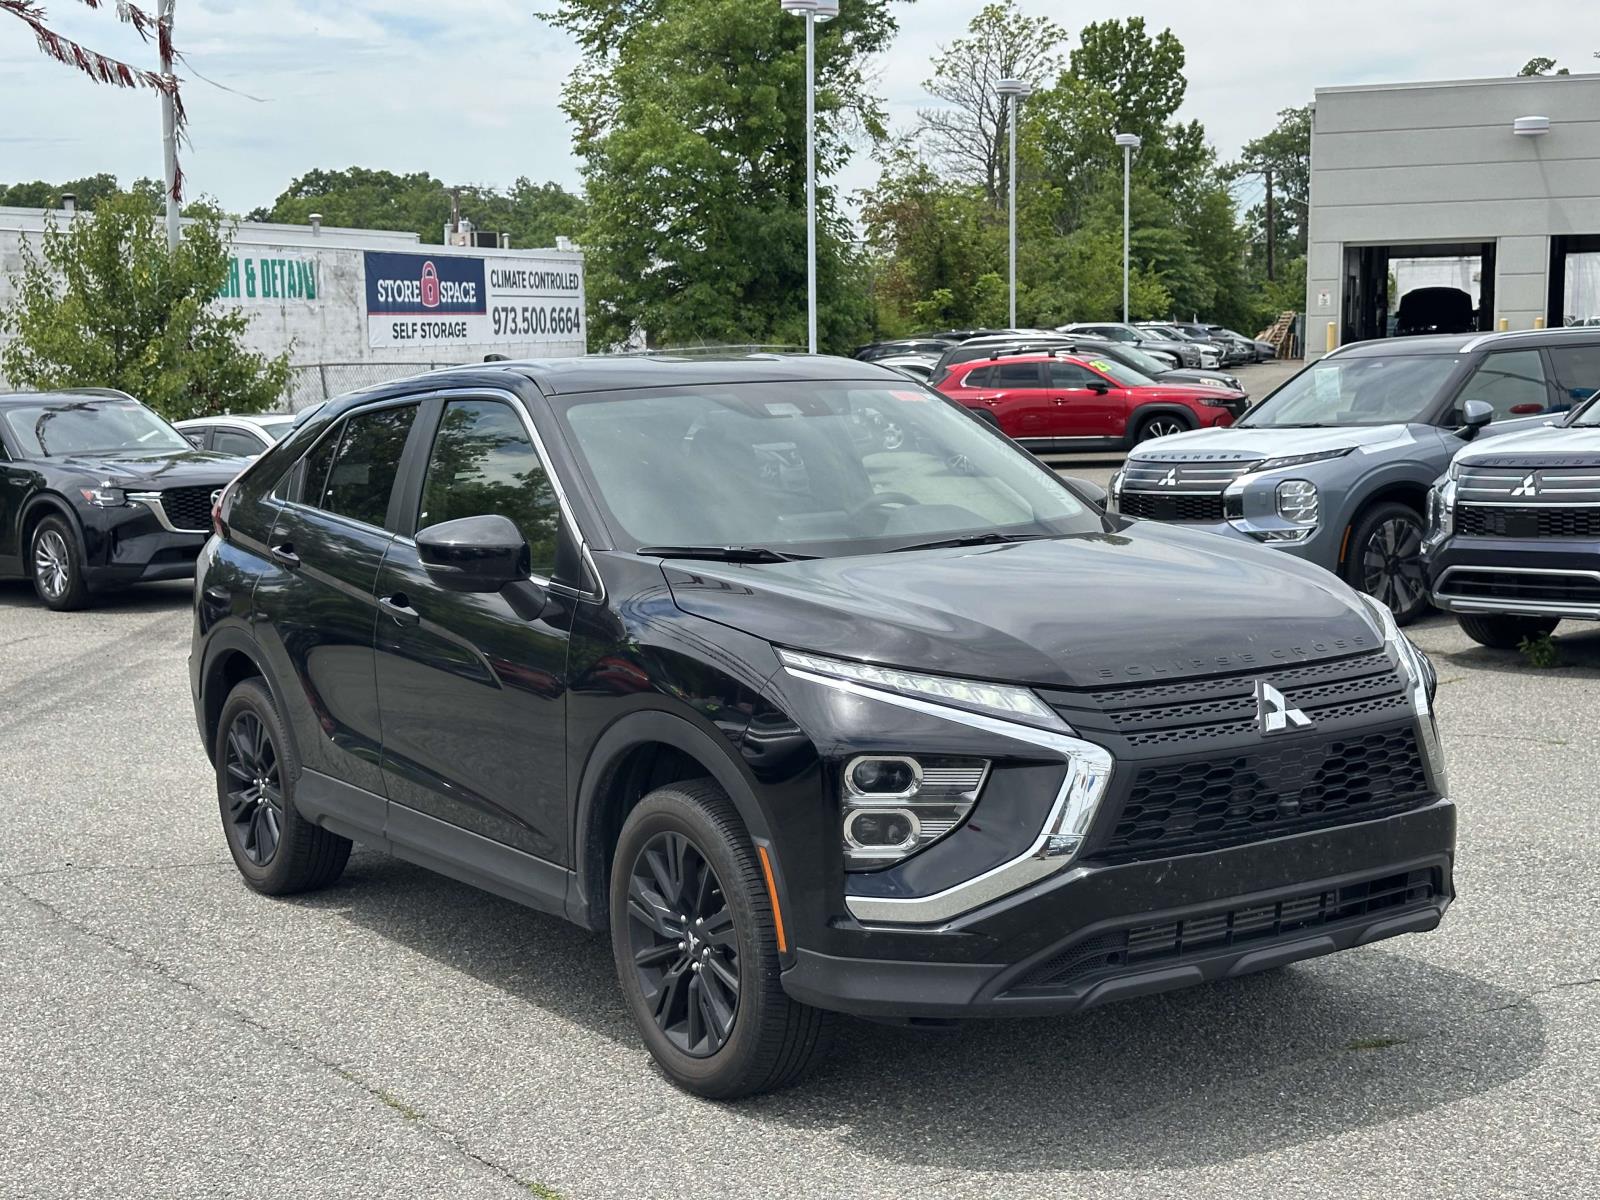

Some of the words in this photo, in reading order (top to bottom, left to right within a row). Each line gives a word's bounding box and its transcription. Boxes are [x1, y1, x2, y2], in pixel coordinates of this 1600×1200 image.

[244, 258, 256, 298] &
[377, 279, 421, 302] STORE
[440, 281, 476, 303] SPACE
[490, 269, 527, 289] CLIMATE
[528, 271, 579, 290] CONTROLLED
[392, 322, 417, 339] SELF
[420, 322, 467, 339] STORAGE
[492, 306, 580, 335] 973.500.6664
[1096, 653, 1256, 678] ECLIPSE
[1270, 635, 1365, 659] CROSS
